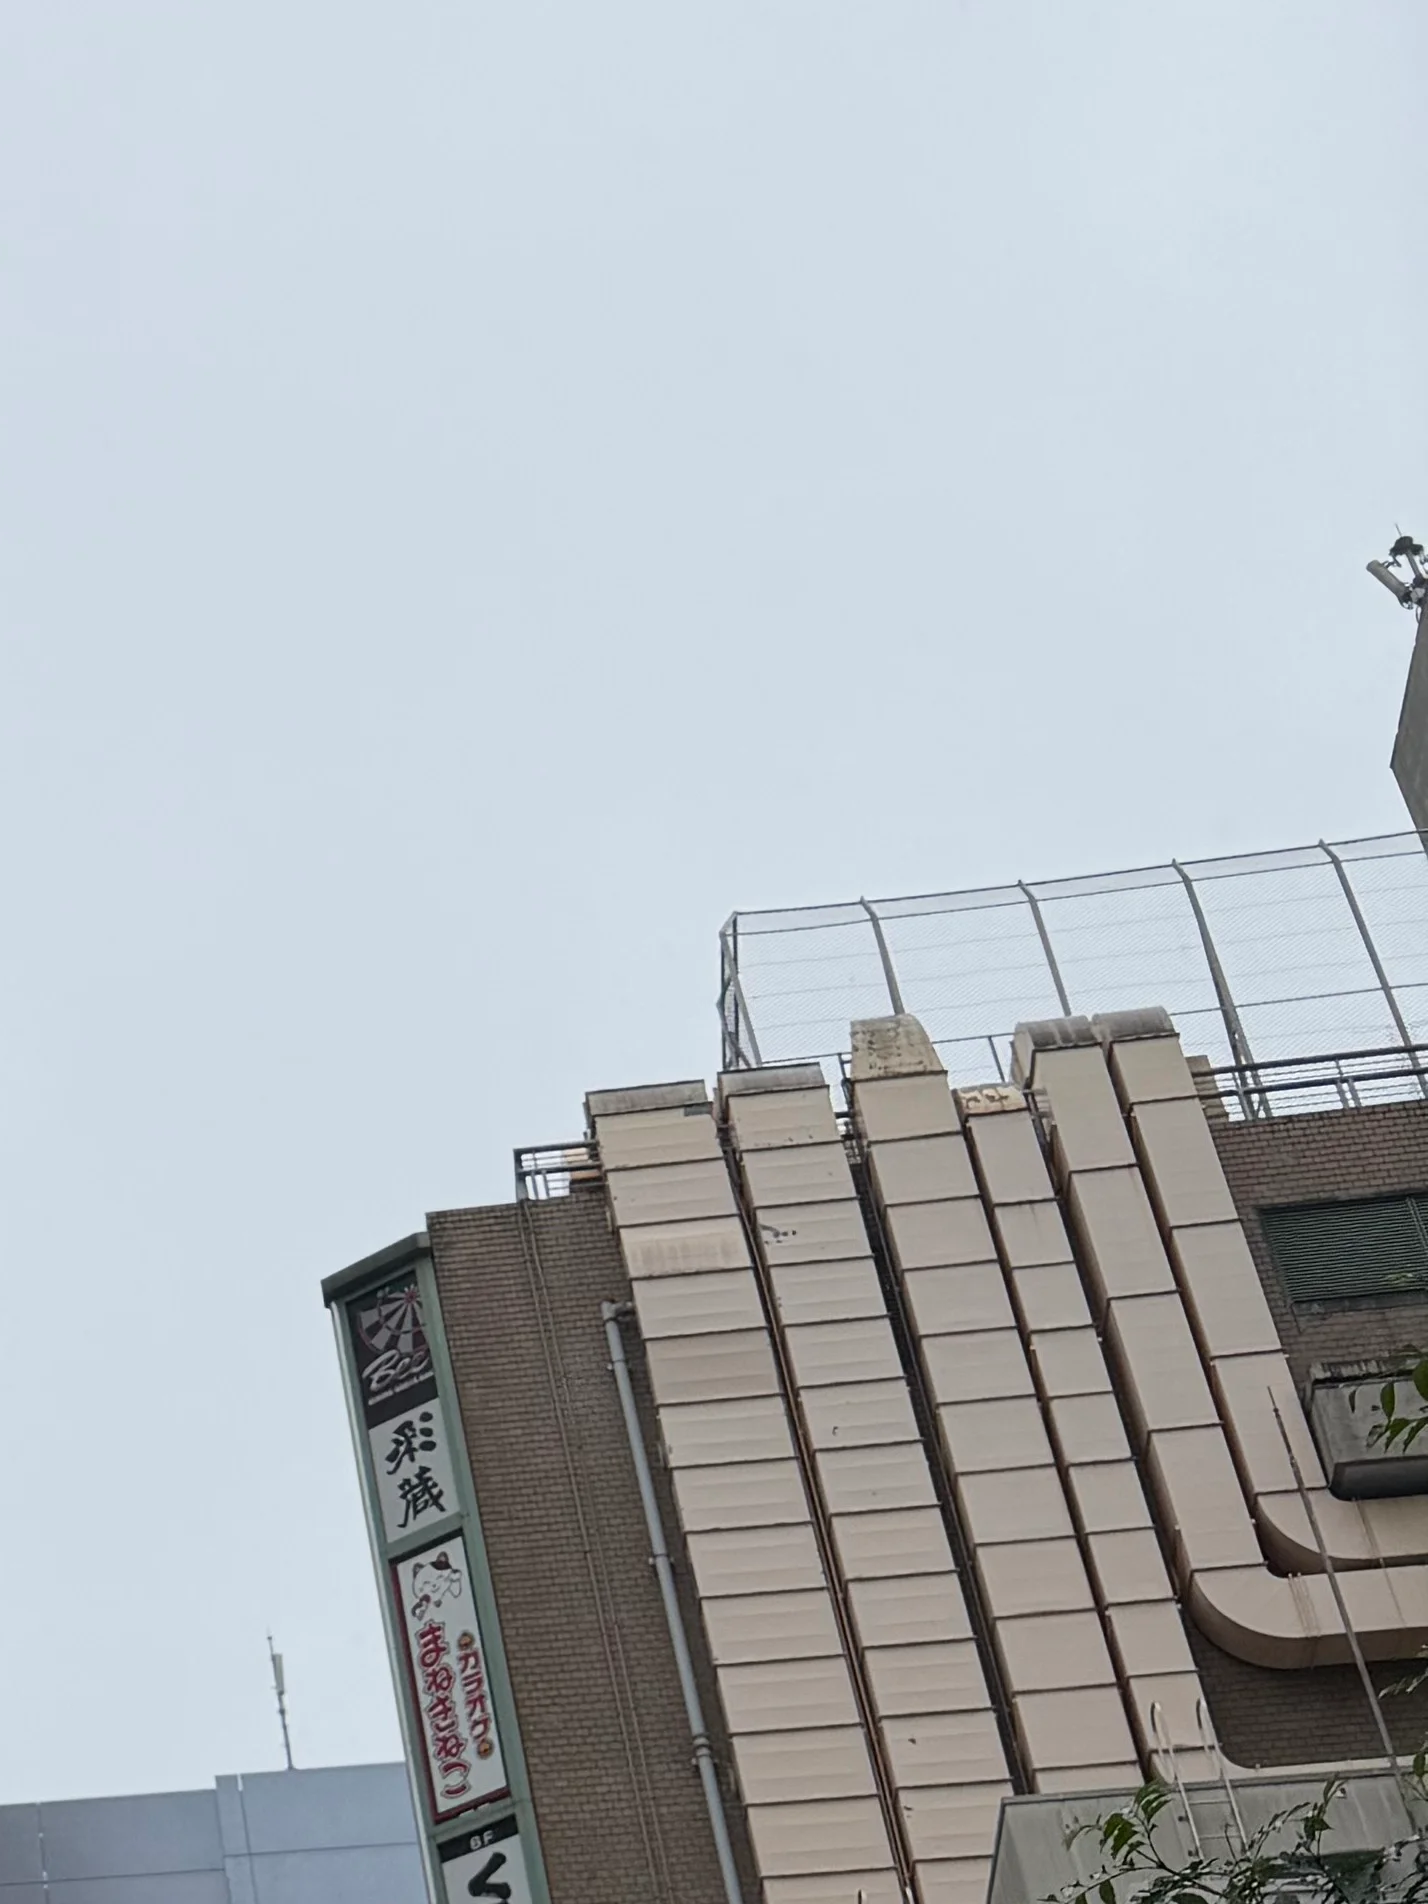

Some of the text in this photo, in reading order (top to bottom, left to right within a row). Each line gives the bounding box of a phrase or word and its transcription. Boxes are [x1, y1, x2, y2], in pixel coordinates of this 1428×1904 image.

[414, 1618, 472, 1800] まねきねこ
[457, 1648, 494, 1742] カラオケ
